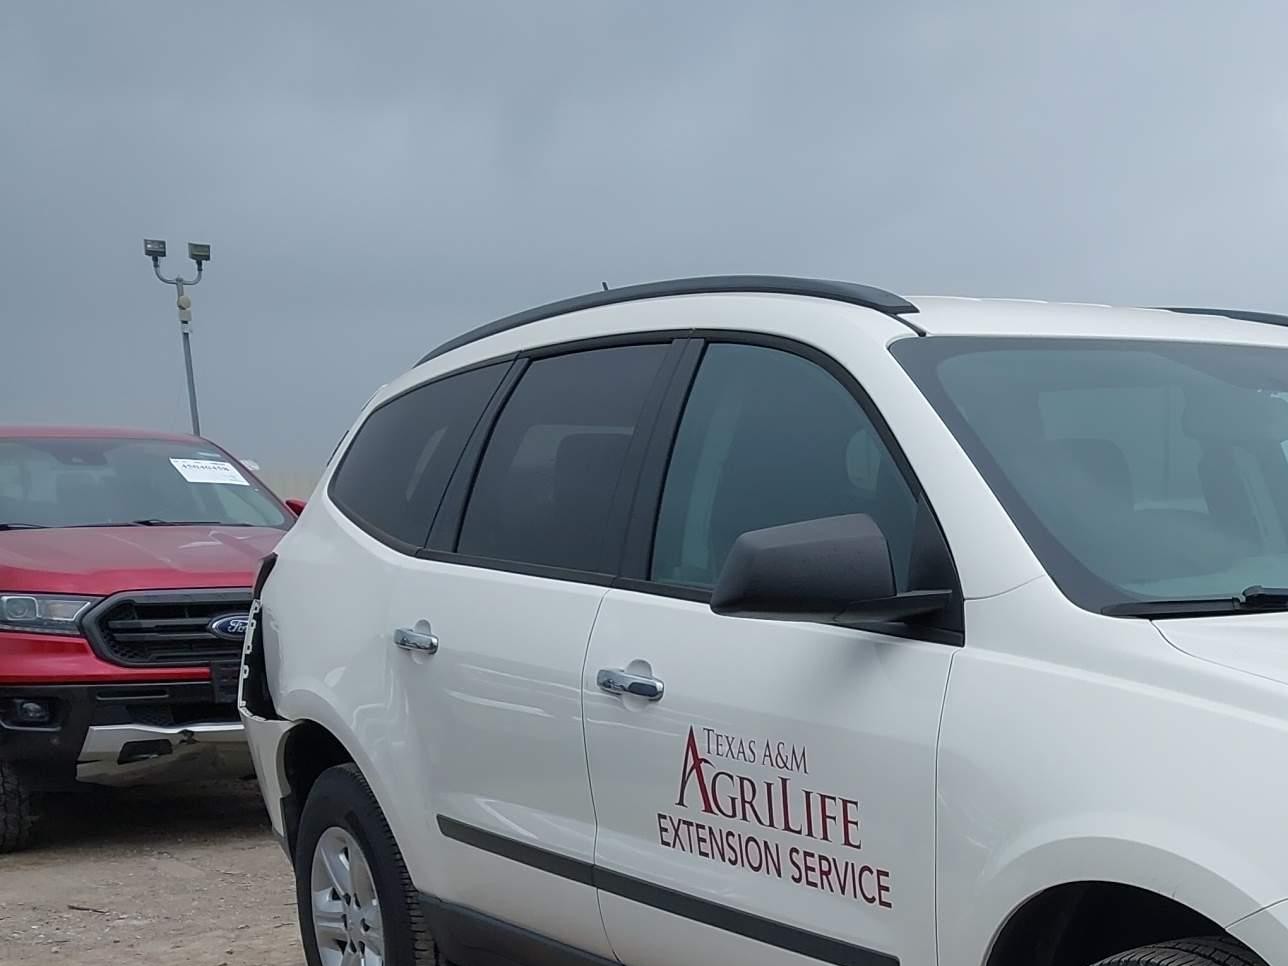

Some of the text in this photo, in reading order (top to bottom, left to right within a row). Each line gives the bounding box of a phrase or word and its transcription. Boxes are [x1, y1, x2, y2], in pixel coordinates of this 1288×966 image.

[763, 738, 809, 775] A&M
[657, 812, 893, 909] EXTENSION SERVICE
